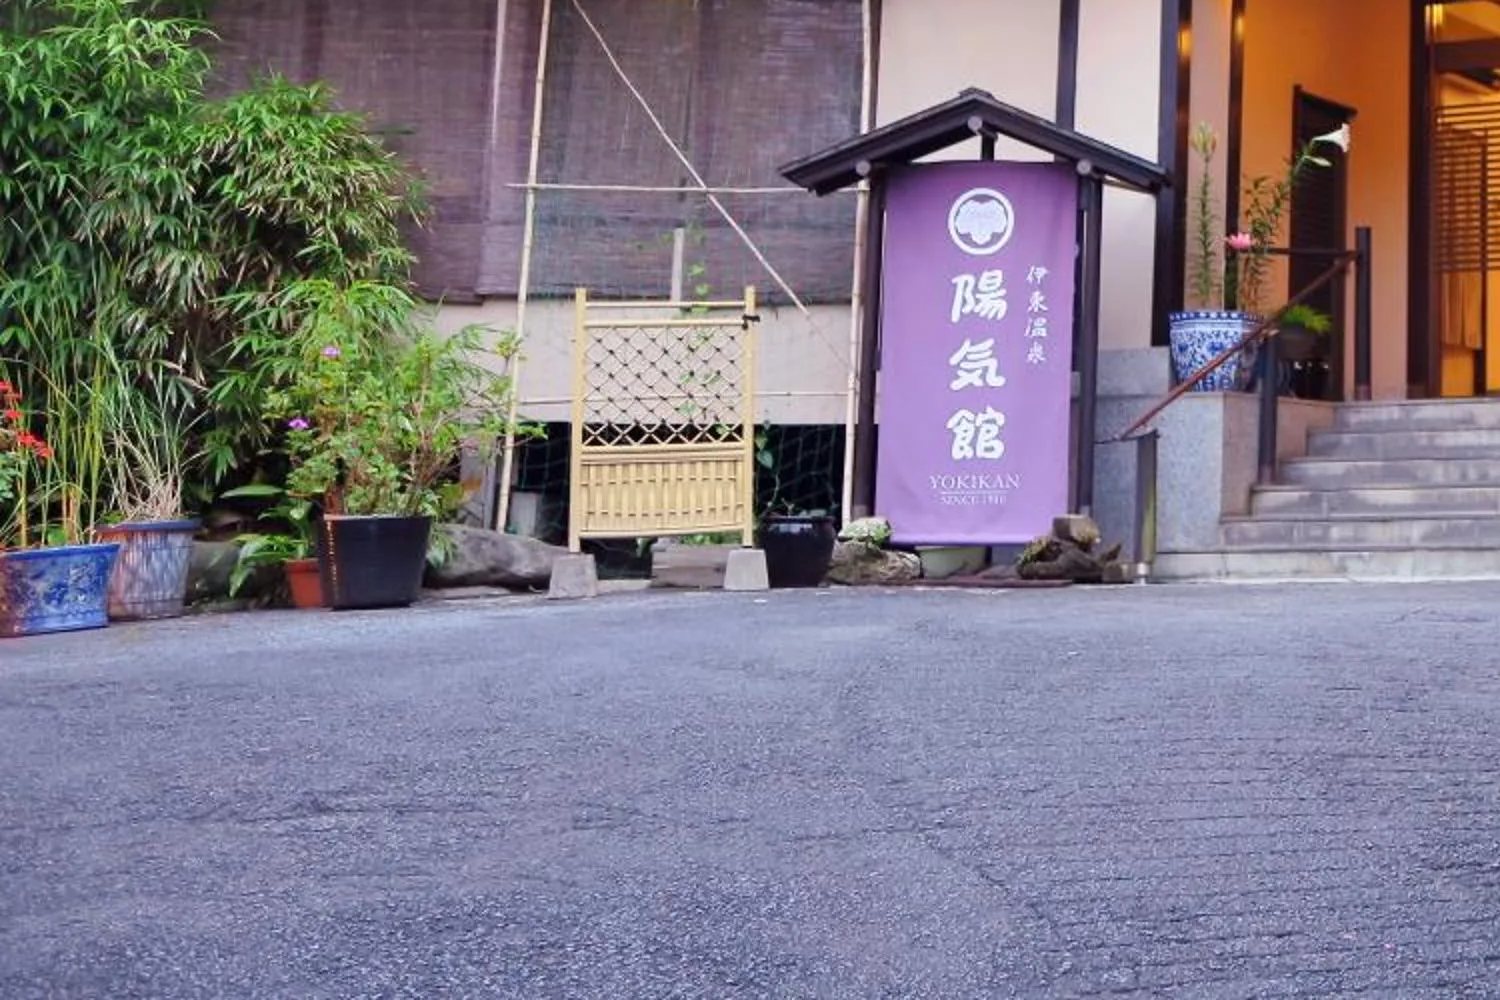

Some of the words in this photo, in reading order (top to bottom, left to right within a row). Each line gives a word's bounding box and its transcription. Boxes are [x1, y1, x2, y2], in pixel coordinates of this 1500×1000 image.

[946, 268, 1008, 461] 陽気館
[1024, 264, 1050, 365] 伊東温泉
[928, 473, 1023, 490] YOKIKAN
